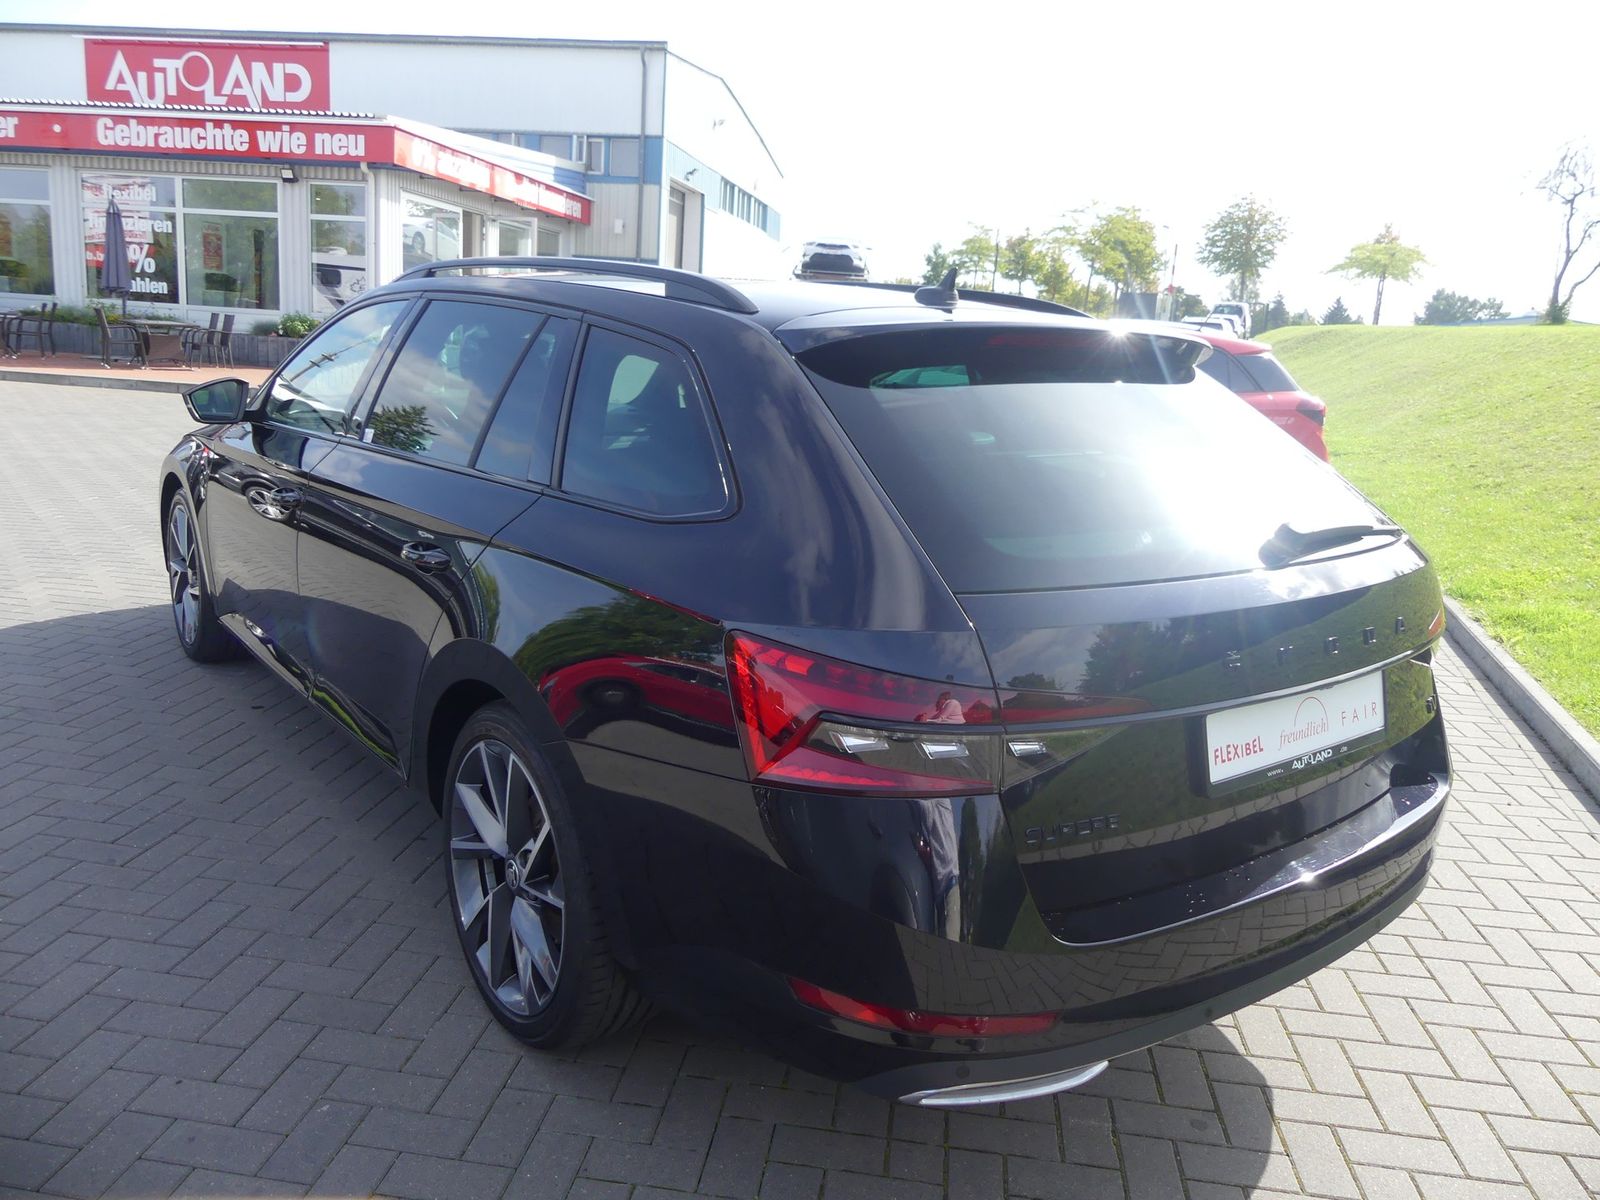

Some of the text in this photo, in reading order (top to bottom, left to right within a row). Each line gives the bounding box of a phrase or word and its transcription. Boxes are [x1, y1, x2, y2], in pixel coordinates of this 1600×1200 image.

[96, 117, 250, 152] Gebrauchte
[256, 125, 307, 154] wie
[314, 132, 366, 157] neu
[1278, 717, 1327, 751] freundlich
[1341, 702, 1377, 726] FAIR
